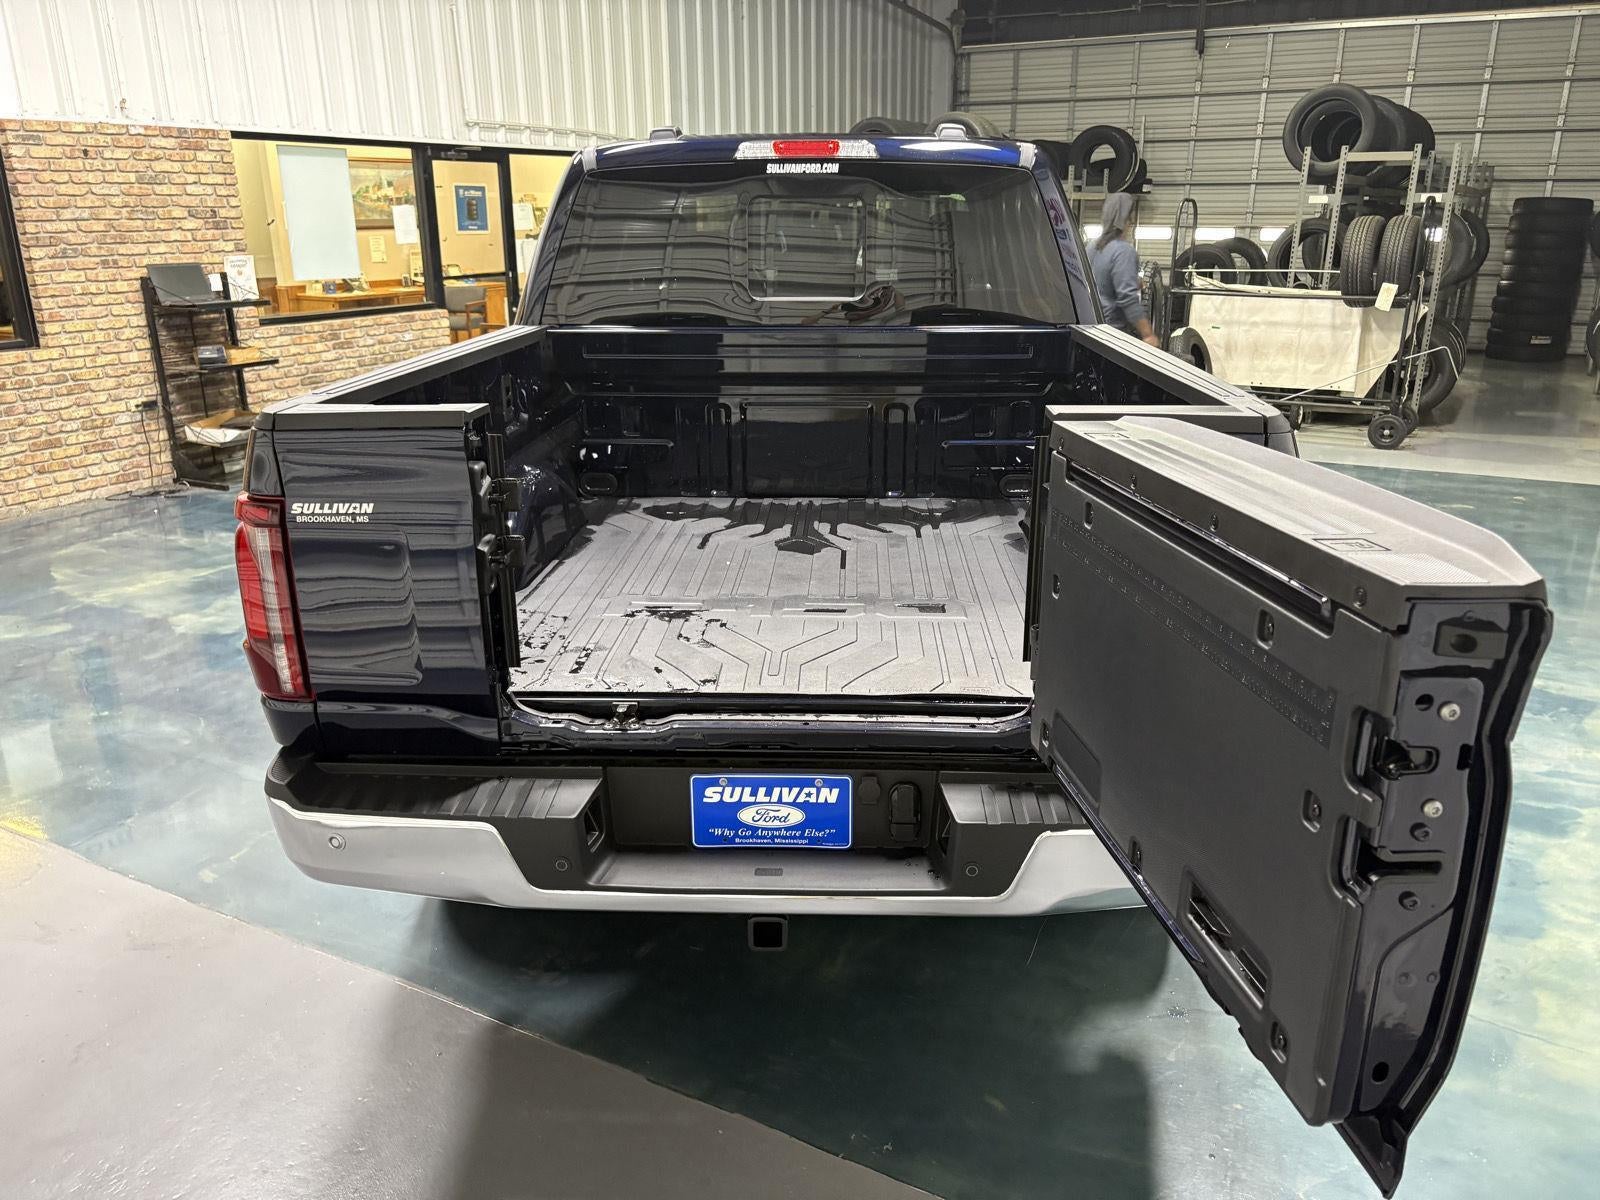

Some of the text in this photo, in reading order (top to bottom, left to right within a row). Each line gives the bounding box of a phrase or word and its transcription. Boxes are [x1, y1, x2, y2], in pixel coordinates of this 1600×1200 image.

[766, 163, 840, 174] SULLIVANFORD.COM
[290, 502, 375, 514] SULLIVAN
[296, 515, 369, 524] BROOKHAVEN, MS
[702, 786, 840, 804] SULLIVAN
[751, 808, 791, 824] Ford
[708, 828, 736, 837] “Why
[738, 828, 752, 836] Go
[754, 828, 802, 838] Anywhere
